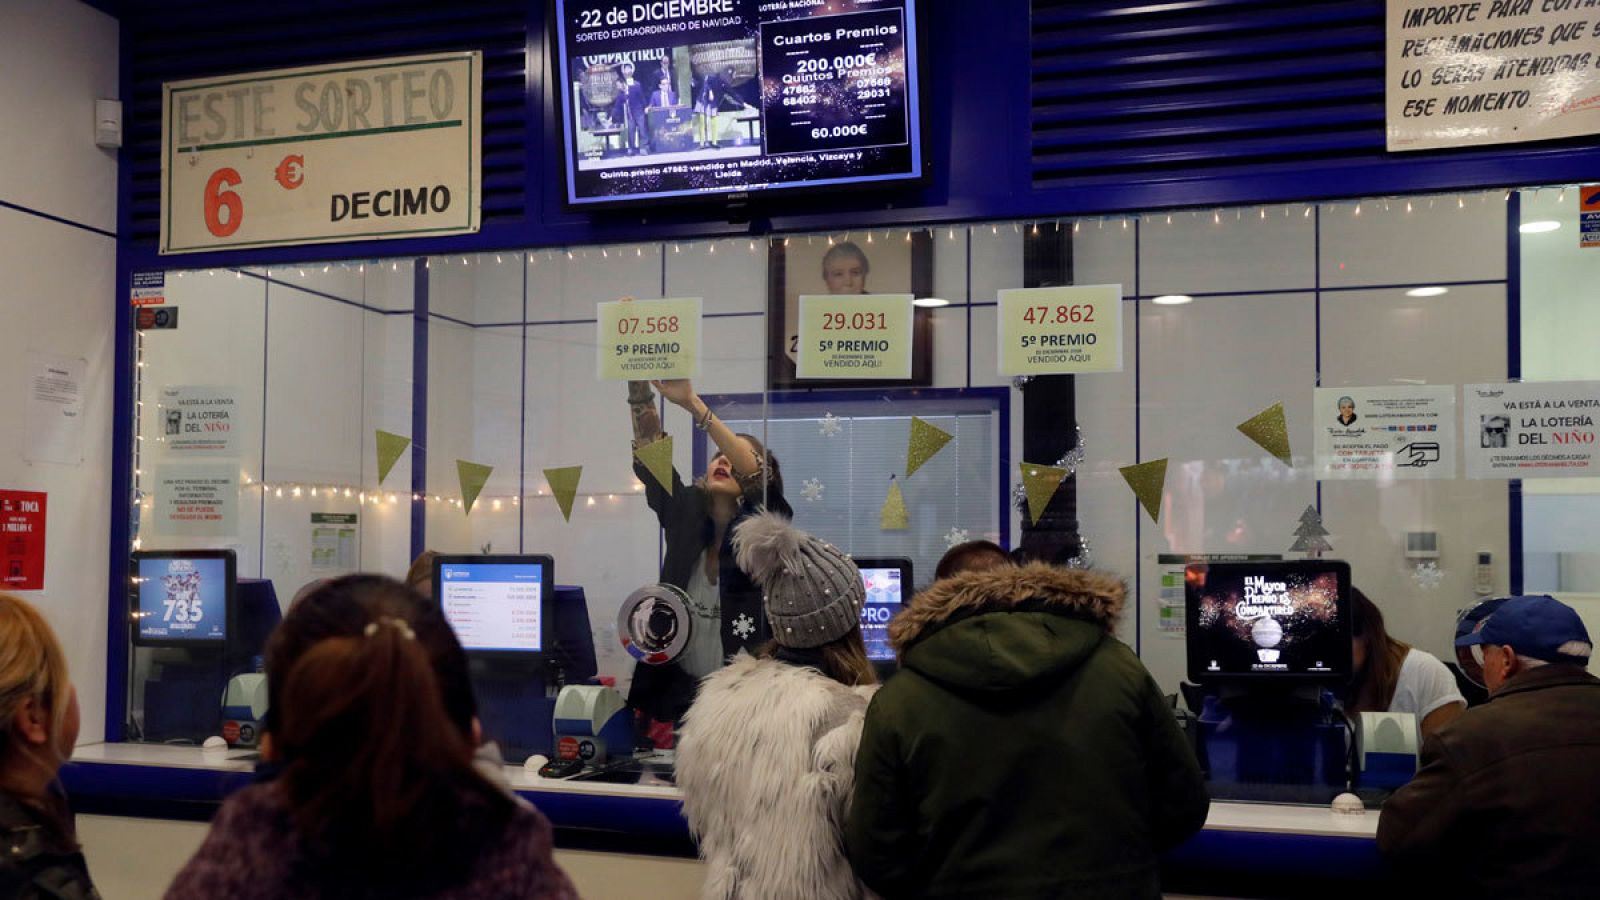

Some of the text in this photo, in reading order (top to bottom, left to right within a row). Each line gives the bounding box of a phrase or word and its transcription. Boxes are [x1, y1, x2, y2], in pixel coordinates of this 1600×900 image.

[581, 0, 734, 28] 22 de DICIEMBRE
[1402, 2, 1481, 29] IMPORTE
[1487, 0, 1532, 19] PARA
[576, 16, 742, 42] SORTEO EXTRAORDINARIO DE NAVIDAD
[773, 25, 898, 46] Cuartos Premios
[1548, 21, 1588, 45] QUE
[797, 52, 877, 73] 200.000€
[1401, 69, 1422, 89] LO
[1493, 52, 1592, 81] ATENDIDAS
[782, 65, 893, 85] Quintos Premios
[178, 68, 454, 144] ESTE SORTEO
[1403, 90, 1532, 118] ESE MOMENTO.
[811, 124, 868, 139] 60.000€
[856, 152, 863, 161] y
[204, 154, 305, 237] 6 €
[331, 184, 451, 222] DECIMO
[823, 312, 888, 330] 29.031
[1023, 304, 1095, 325] 47.862
[618, 316, 679, 335] 07.568
[616, 342, 680, 356] 5º PREMIO
[819, 339, 889, 352] 5º PREMIO
[1021, 333, 1097, 347] 5º PREMIO
[621, 362, 654, 370] VENDIDO
[823, 360, 860, 368] VENDIDO
[1027, 355, 1067, 363] VENDIDO
[1504, 402, 1517, 410] YA
[1544, 400, 1553, 408] A
[1553, 400, 1565, 408] LA
[187, 409, 229, 420] LA LOTERÍA
[1521, 415, 1593, 428] LA LOTERÍA
[185, 420, 230, 432] DEL NIÑO
[1518, 429, 1595, 445] DEL NIÑO
[21, 501, 39, 512] TOCA
[163, 600, 203, 621] 735
